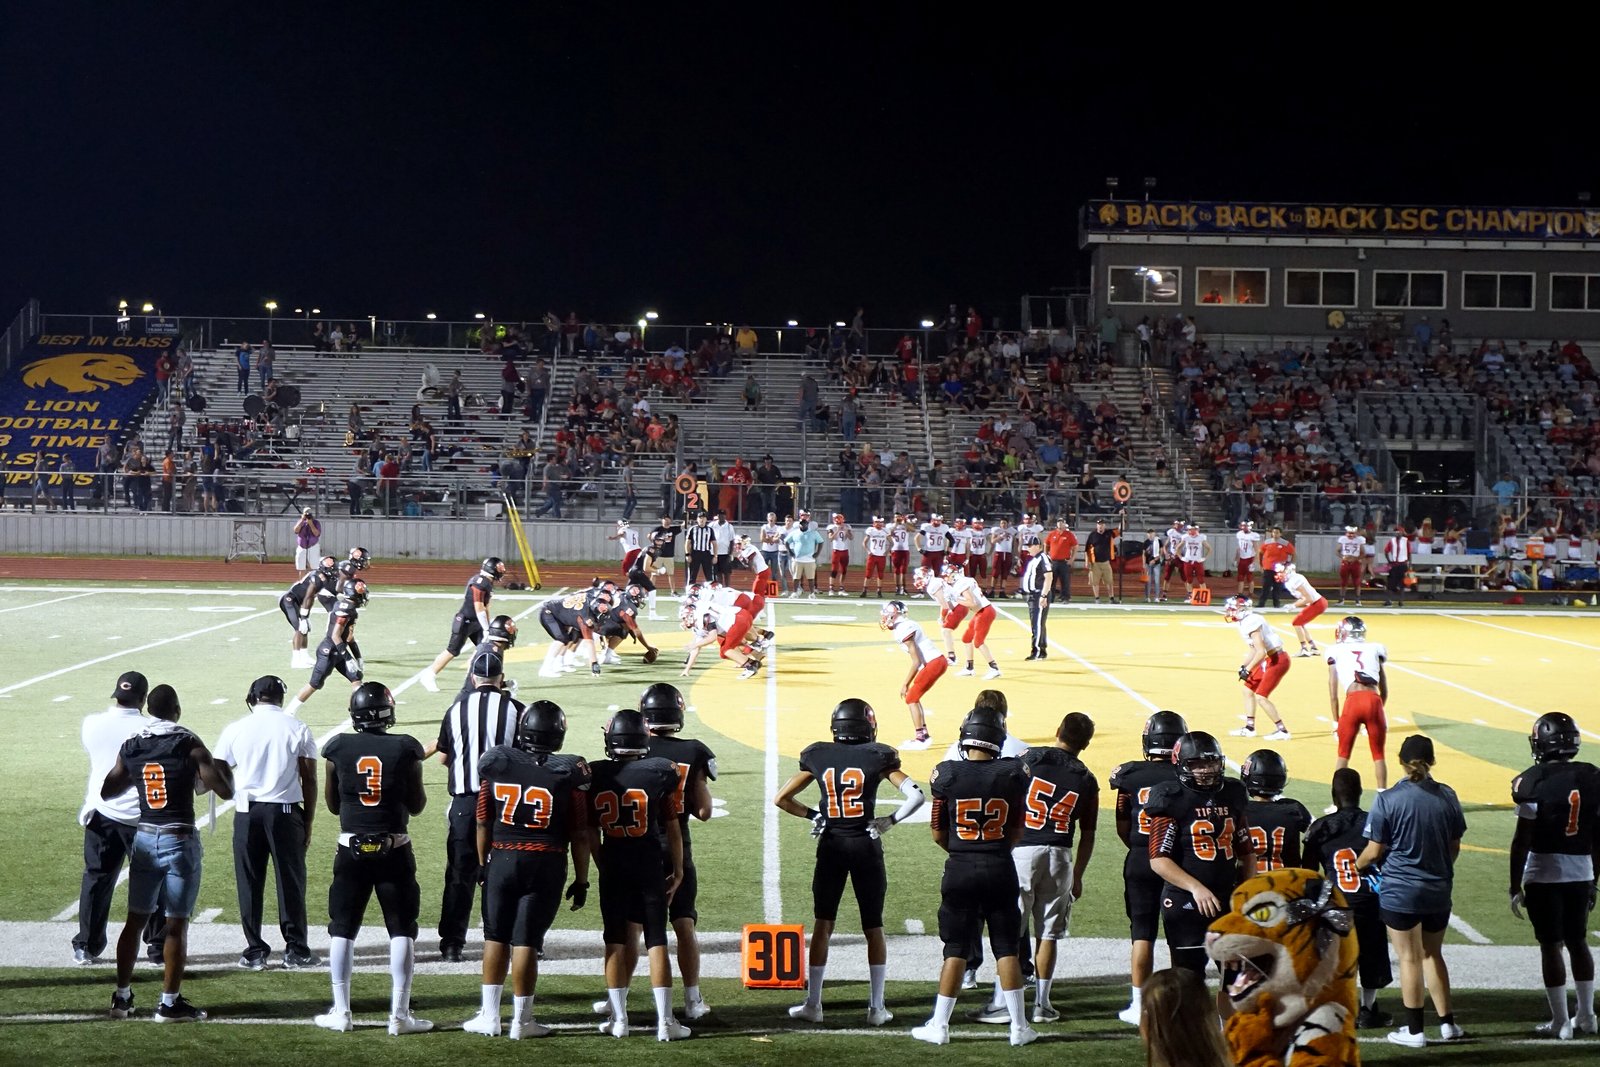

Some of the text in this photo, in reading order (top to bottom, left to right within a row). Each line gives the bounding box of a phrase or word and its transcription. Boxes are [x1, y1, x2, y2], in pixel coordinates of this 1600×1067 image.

[1126, 204, 1198, 227] BACK
[1199, 209, 1212, 221] to
[1215, 205, 1288, 228] BACK
[1289, 210, 1302, 223] to
[1304, 206, 1377, 230] BACK
[1384, 208, 1439, 231] LSC
[37, 334, 173, 348] BEST IN CLASS
[24, 400, 100, 412] LION
[30, 435, 106, 448] TIME
[687, 493, 699, 509] 2
[1193, 590, 1209, 603] 40
[120, 681, 132, 690] C
[142, 762, 168, 809] 8
[356, 756, 382, 807] 3
[822, 766, 866, 819] 12
[494, 782, 553, 829] 73
[594, 788, 649, 838] 23
[956, 798, 1009, 840] 52
[1025, 776, 1079, 834] 54
[1565, 789, 1581, 837] 1
[1190, 817, 1235, 861] 64
[1163, 897, 1173, 908] C
[748, 930, 801, 981] 30
